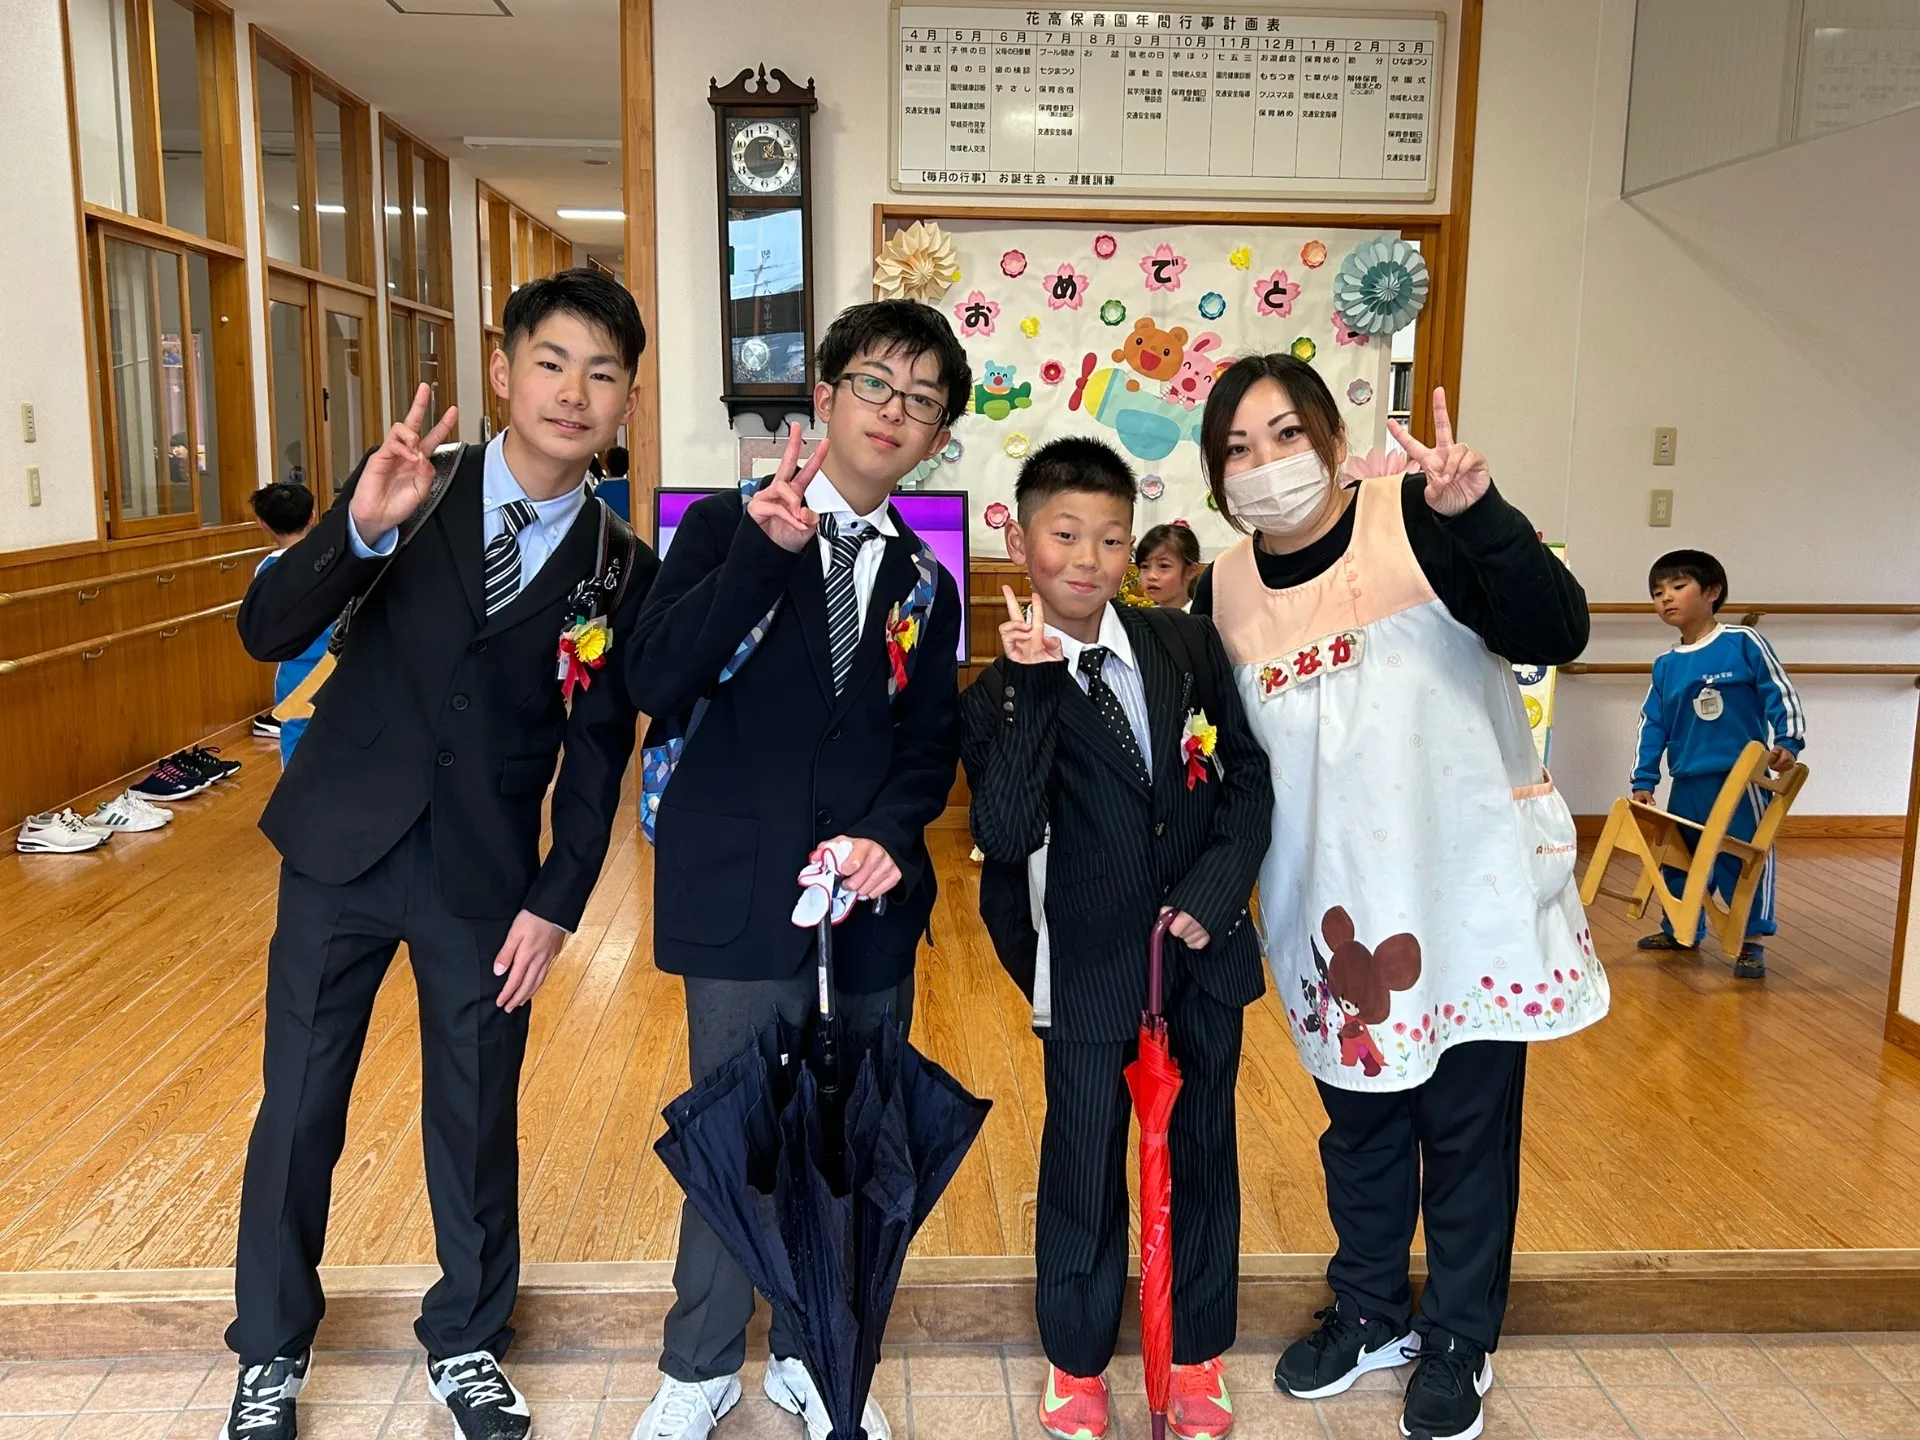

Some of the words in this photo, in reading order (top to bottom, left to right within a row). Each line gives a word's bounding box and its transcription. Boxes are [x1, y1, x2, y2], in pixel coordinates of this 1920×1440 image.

[1026, 11, 1280, 32] 花高保育園年間行事計画表
[910, 30, 936, 41] 4月
[955, 31, 981, 41] 5月
[1000, 32, 1026, 42] 6月
[1045, 33, 1071, 44] 7月
[1089, 34, 1115, 45] 8月
[1134, 35, 1160, 46] 9月
[1176, 36, 1206, 47] 10月
[1220, 38, 1250, 48] 11月
[1264, 39, 1294, 50] 12月
[1311, 40, 1335, 51] 1月
[1354, 41, 1379, 52] 2月
[950, 47, 986, 55] 子供の日
[1398, 42, 1423, 53] 3月
[1129, 51, 1164, 59] 敬老の日
[1392, 58, 1427, 66] ひなまつり
[950, 65, 986, 73] 母の日
[1040, 67, 1075, 75] 七夕まつり
[759, 126, 769, 134] 12
[784, 140, 791, 148] 2
[738, 166, 746, 174] 8
[761, 180, 769, 188] 6
[1260, 636, 1351, 694] たなか
